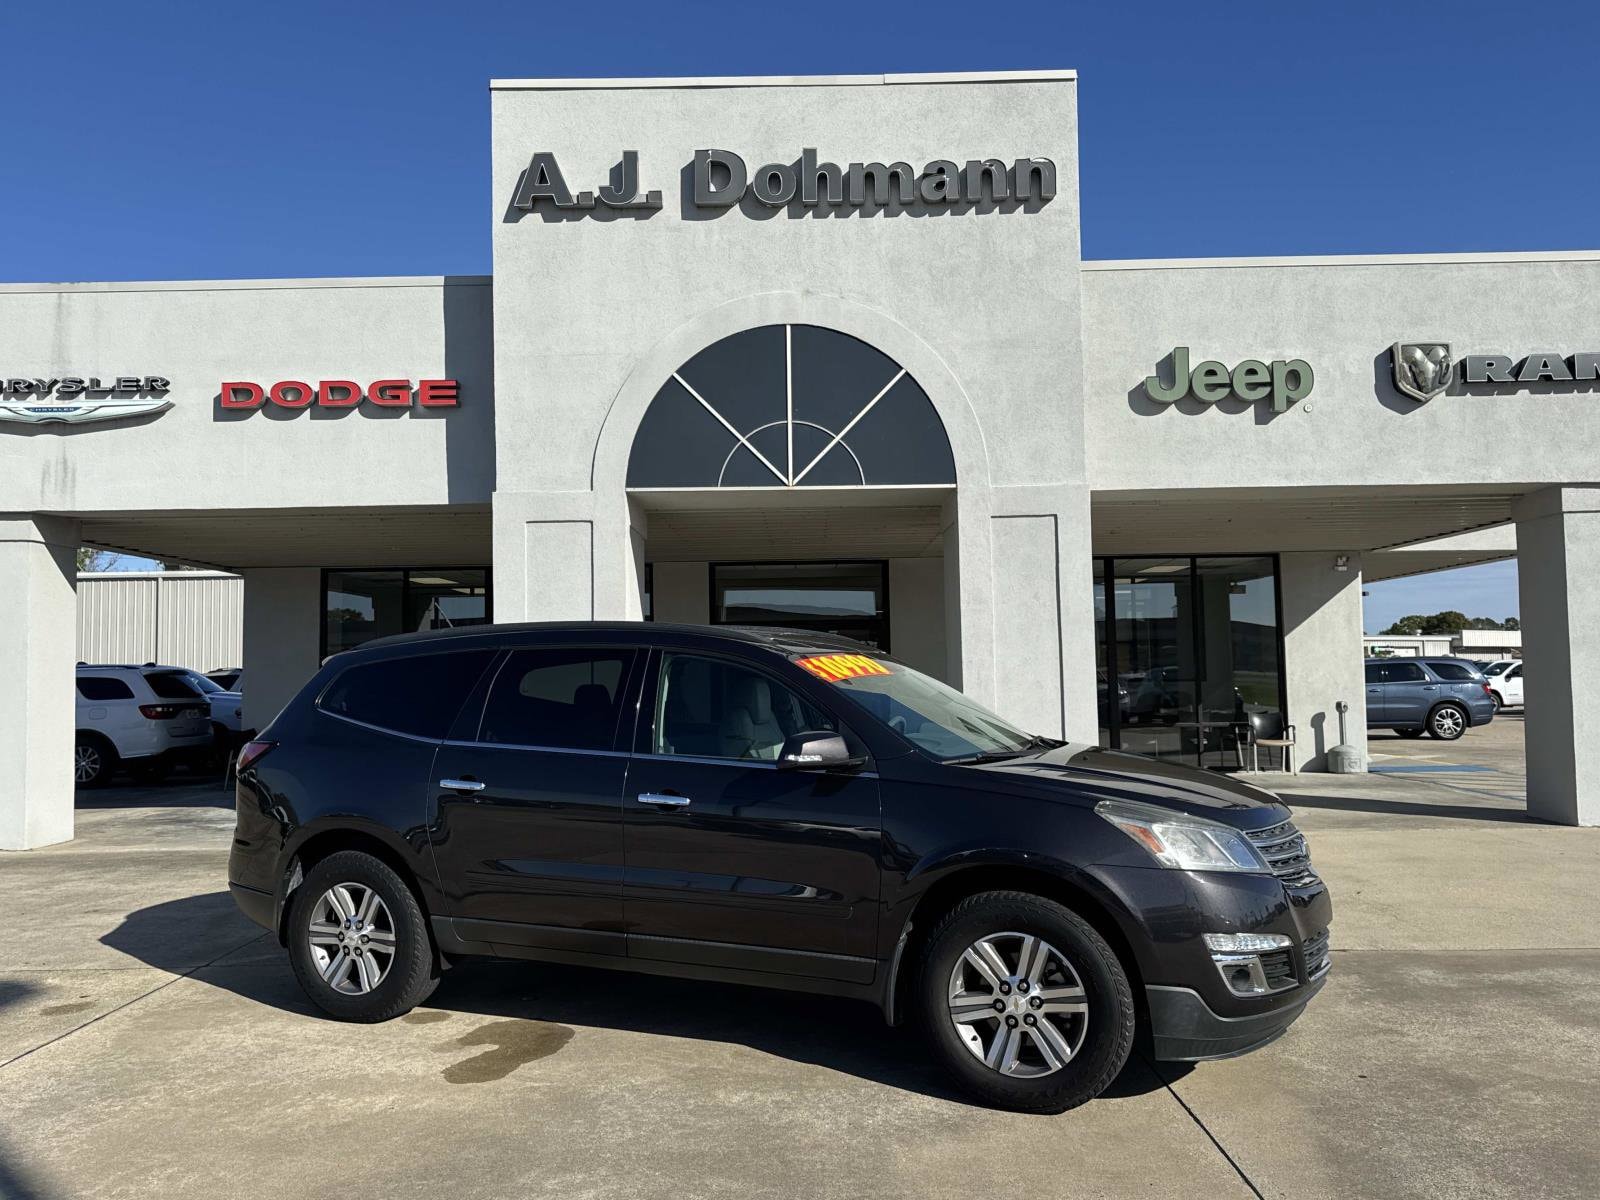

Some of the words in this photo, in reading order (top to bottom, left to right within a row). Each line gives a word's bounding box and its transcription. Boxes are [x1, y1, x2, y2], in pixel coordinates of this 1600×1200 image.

[513, 149, 663, 208] A.J.
[694, 146, 1058, 207] Dohmann
[0, 375, 170, 393] RYSLER
[221, 378, 459, 409] DODGE
[1145, 346, 1315, 413] Jeep
